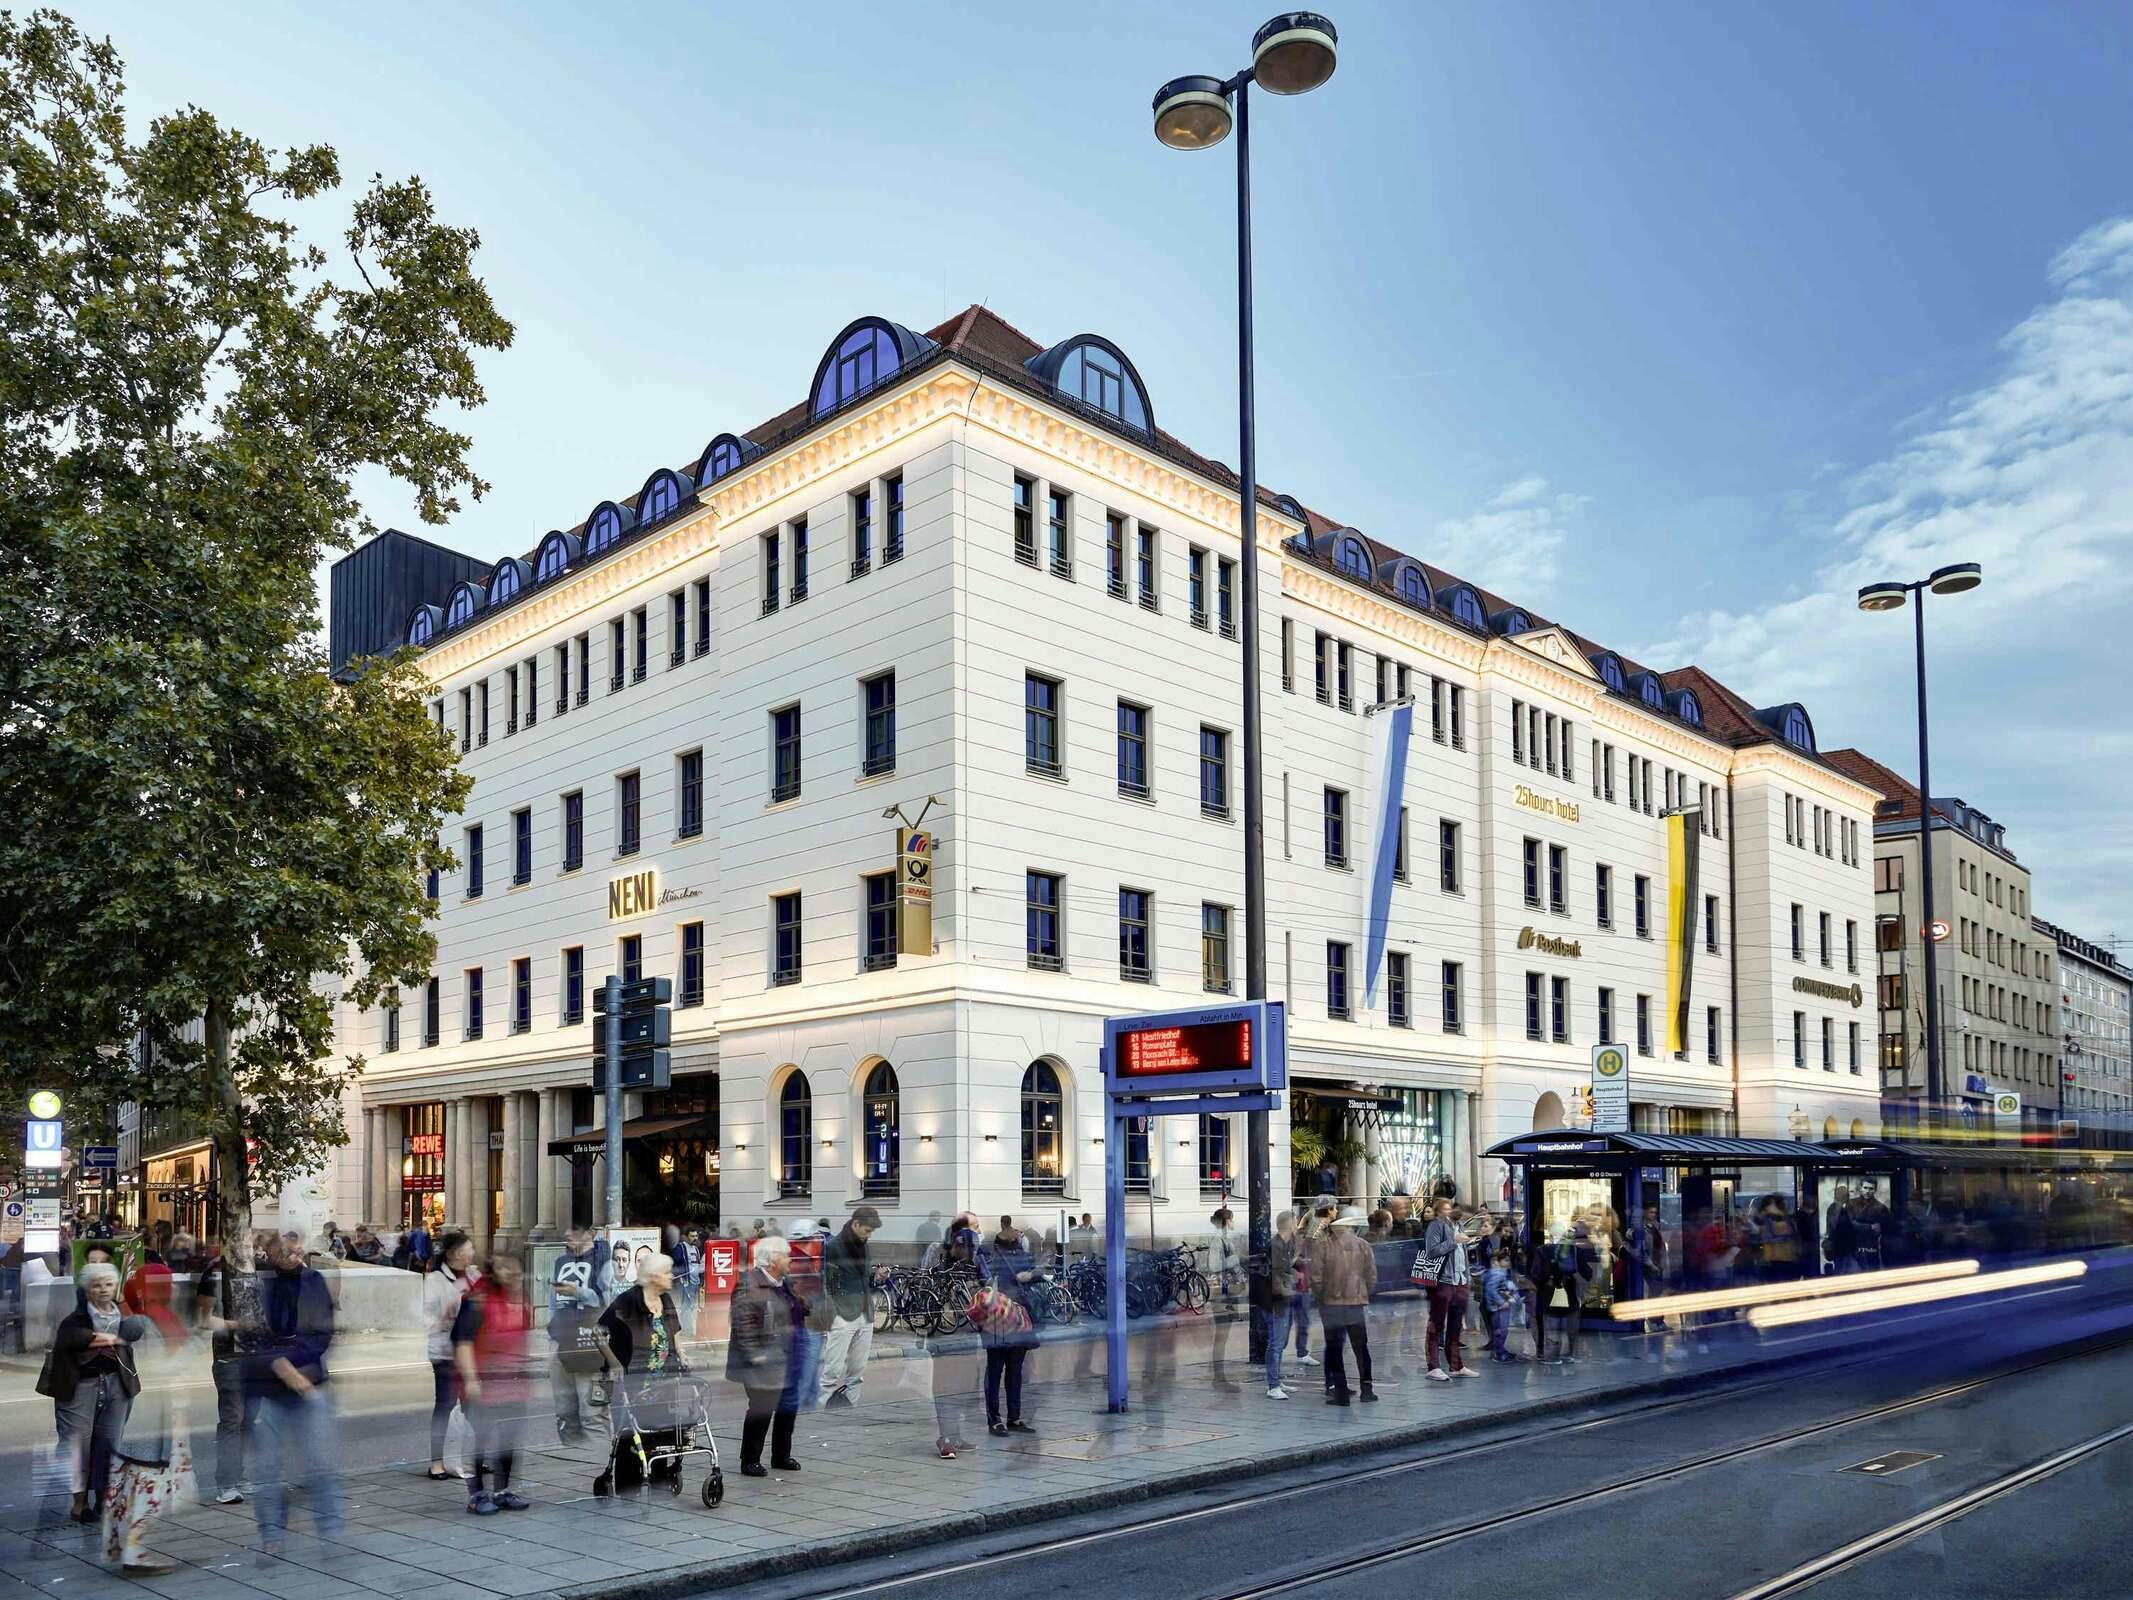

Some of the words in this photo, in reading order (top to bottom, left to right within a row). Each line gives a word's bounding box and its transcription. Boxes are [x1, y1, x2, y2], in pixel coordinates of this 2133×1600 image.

[1515, 784, 1553, 814] 25hours
[1556, 797, 1579, 823] hotel
[609, 870, 655, 920] NENI
[907, 887, 928, 897] DHL
[1537, 933, 1582, 958] Postbank
[1141, 1030, 1180, 1041] Westfriedhof
[1348, 1099, 1366, 1109] 25hours
[1366, 1100, 1377, 1109] hotel
[34, 1125, 55, 1148] U
[413, 1135, 441, 1154] REWE
[573, 1144, 583, 1153] Life
[1537, 1142, 1584, 1151] Hauptbahnhof
[712, 1249, 733, 1273] tz
